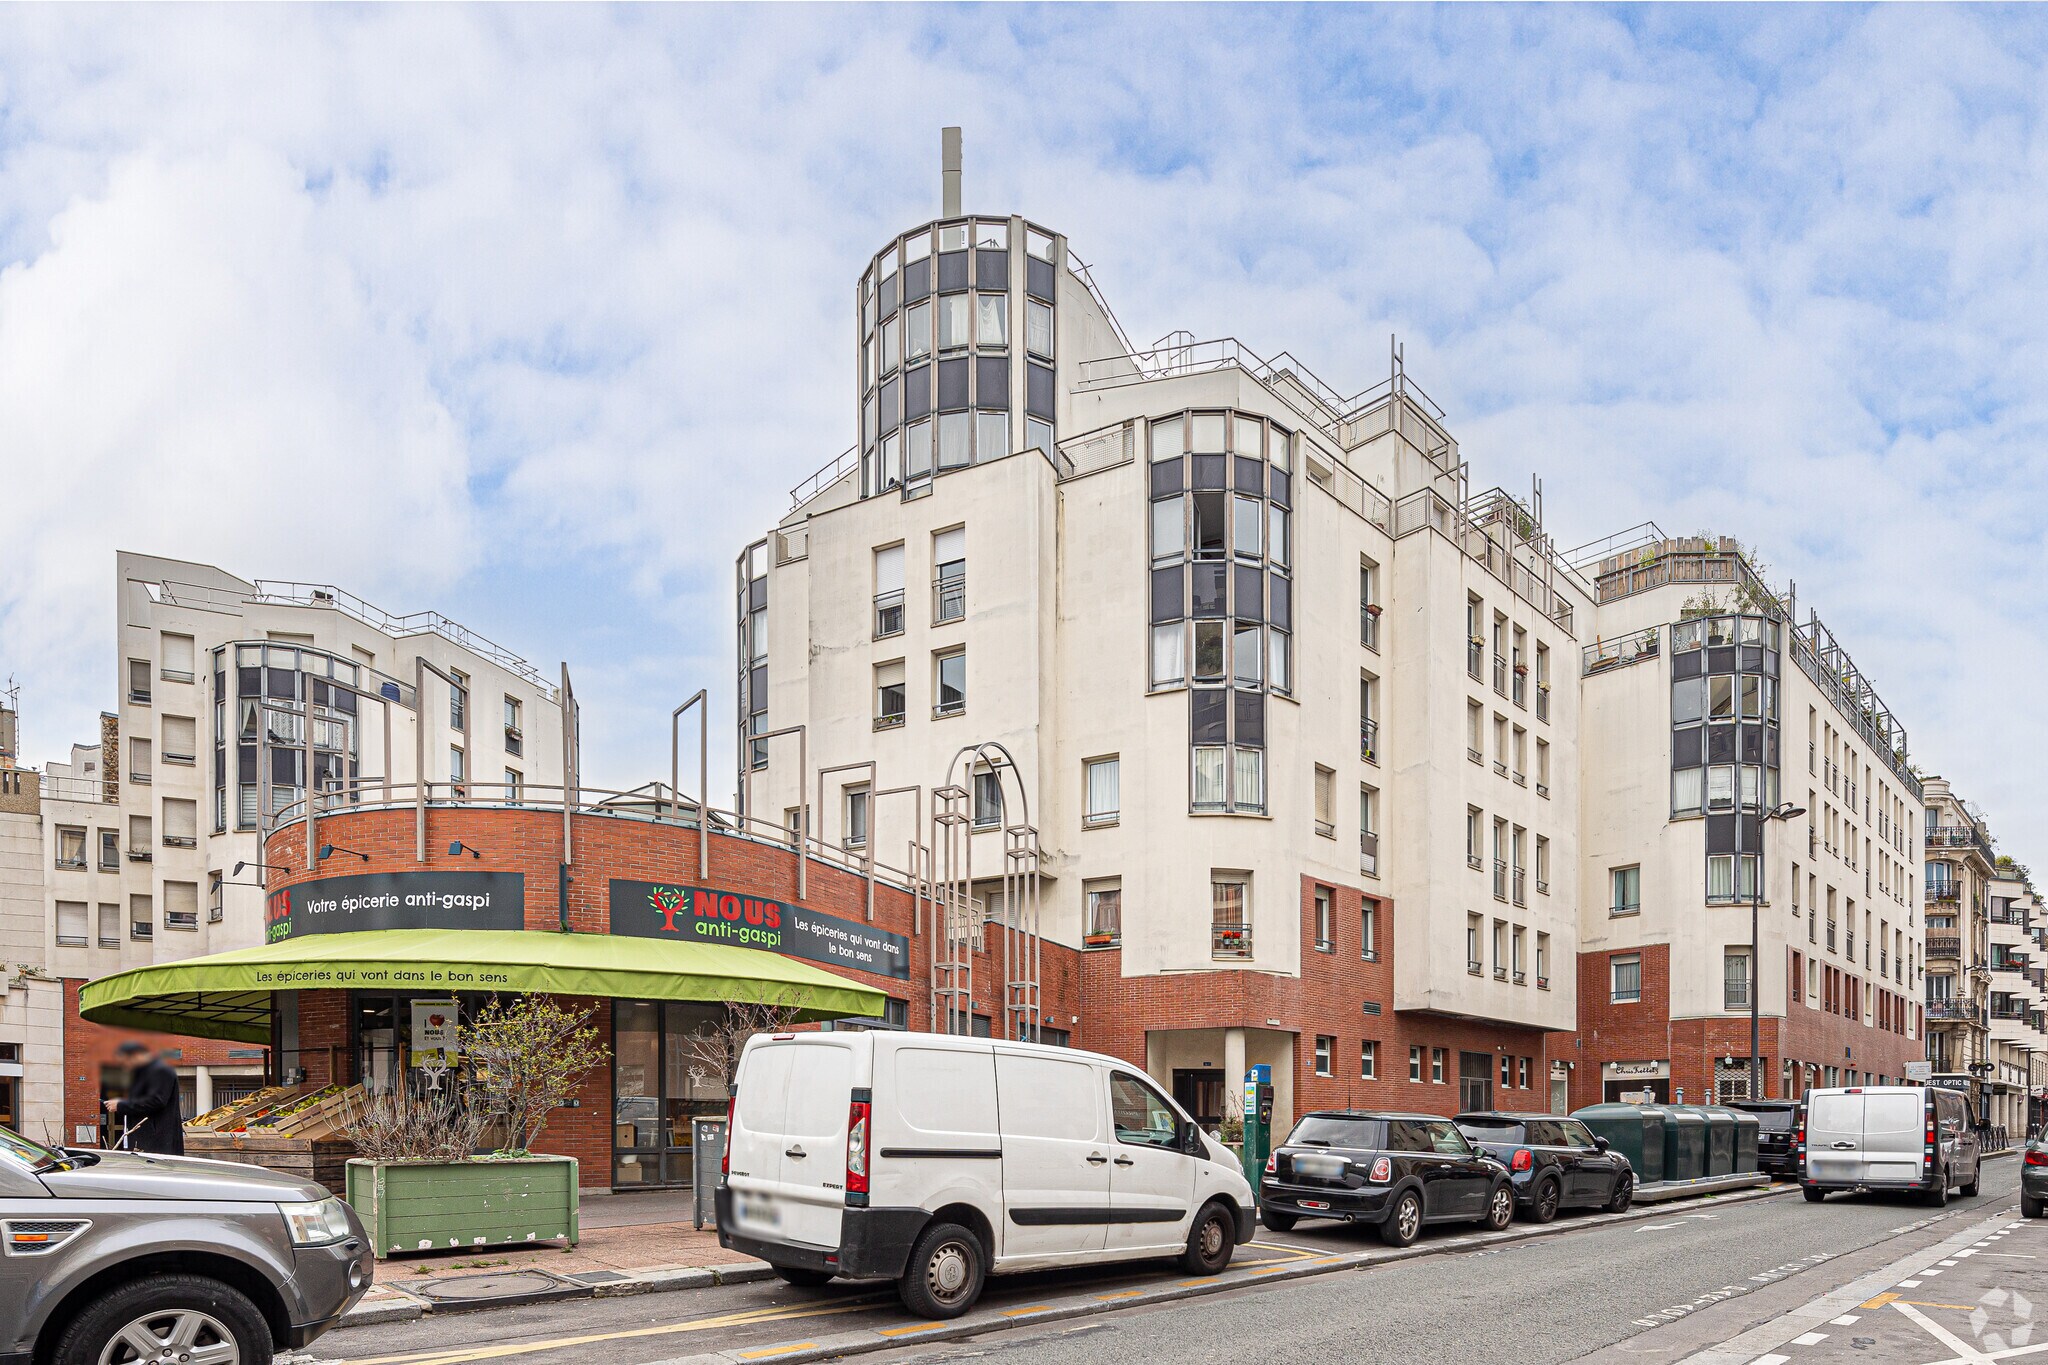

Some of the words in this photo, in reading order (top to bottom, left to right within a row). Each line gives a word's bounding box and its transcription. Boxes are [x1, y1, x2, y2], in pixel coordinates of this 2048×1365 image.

[307, 898, 337, 914] Votre
[341, 893, 399, 913] épicerie
[405, 891, 490, 911] anti-gaspi
[693, 890, 781, 928] NOUS
[695, 920, 781, 948] anti-gaspi
[795, 916, 808, 931] Les
[811, 920, 848, 942] épiceries
[850, 930, 862, 946] qui
[865, 936, 881, 949] vont
[883, 940, 900, 955] dans
[829, 942, 836, 954] le
[839, 944, 854, 958] bon
[856, 950, 873, 963] sens
[256, 971, 273, 982] Les
[277, 970, 331, 982] épiceries
[336, 970, 356, 982] qui
[362, 970, 389, 981] vont
[393, 970, 425, 981] dans
[430, 970, 442, 981] le
[448, 971, 474, 982] bon
[479, 973, 508, 983] sens
[1251, 1070, 1258, 1081] P
